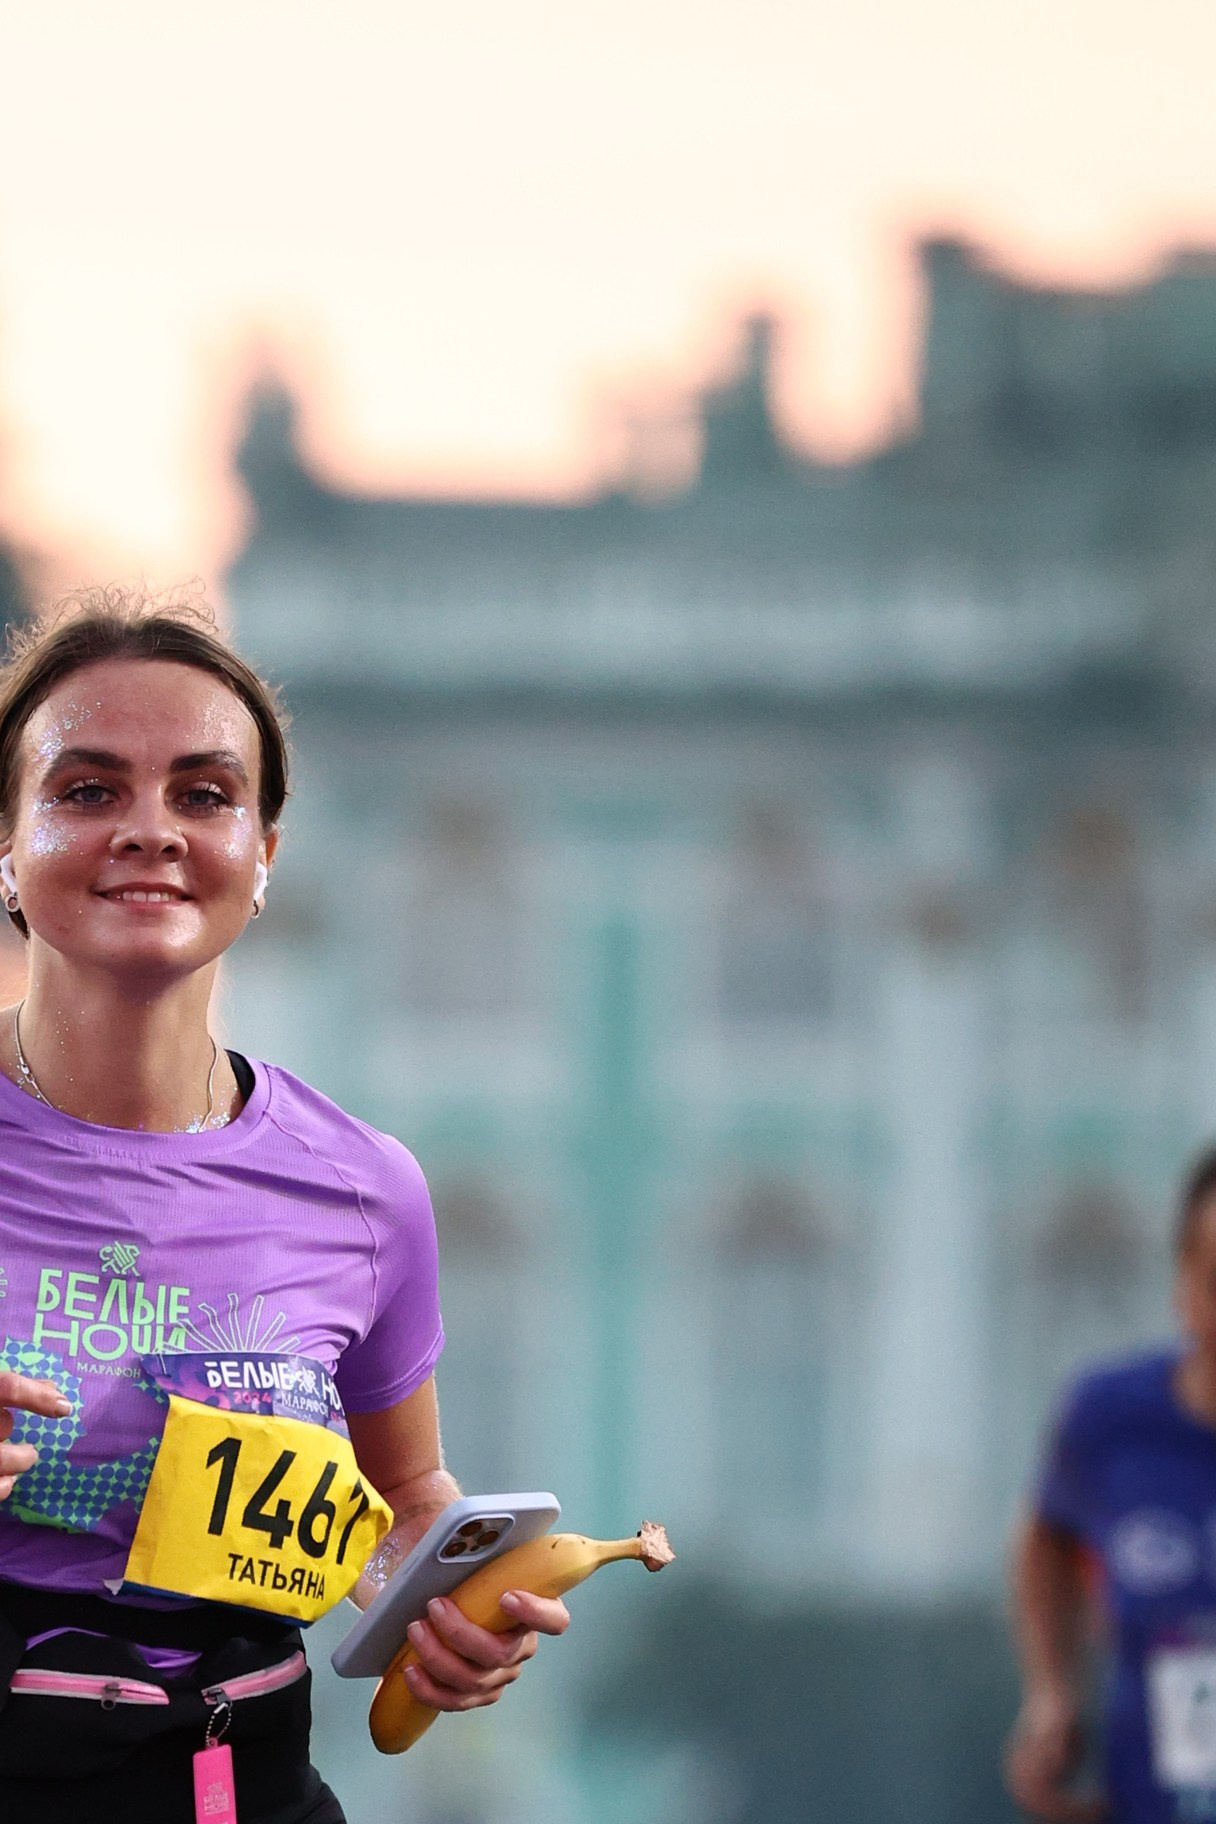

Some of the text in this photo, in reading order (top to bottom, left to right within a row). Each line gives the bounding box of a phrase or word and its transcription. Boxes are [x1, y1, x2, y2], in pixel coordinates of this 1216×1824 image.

[36, 1268, 190, 1325] БЕЛЫЕ
[76, 1361, 141, 1378] МАРАФОН
[204, 1360, 295, 1391] БЕЛЫЕ
[228, 1552, 326, 1601] ТАТЬЯНА
